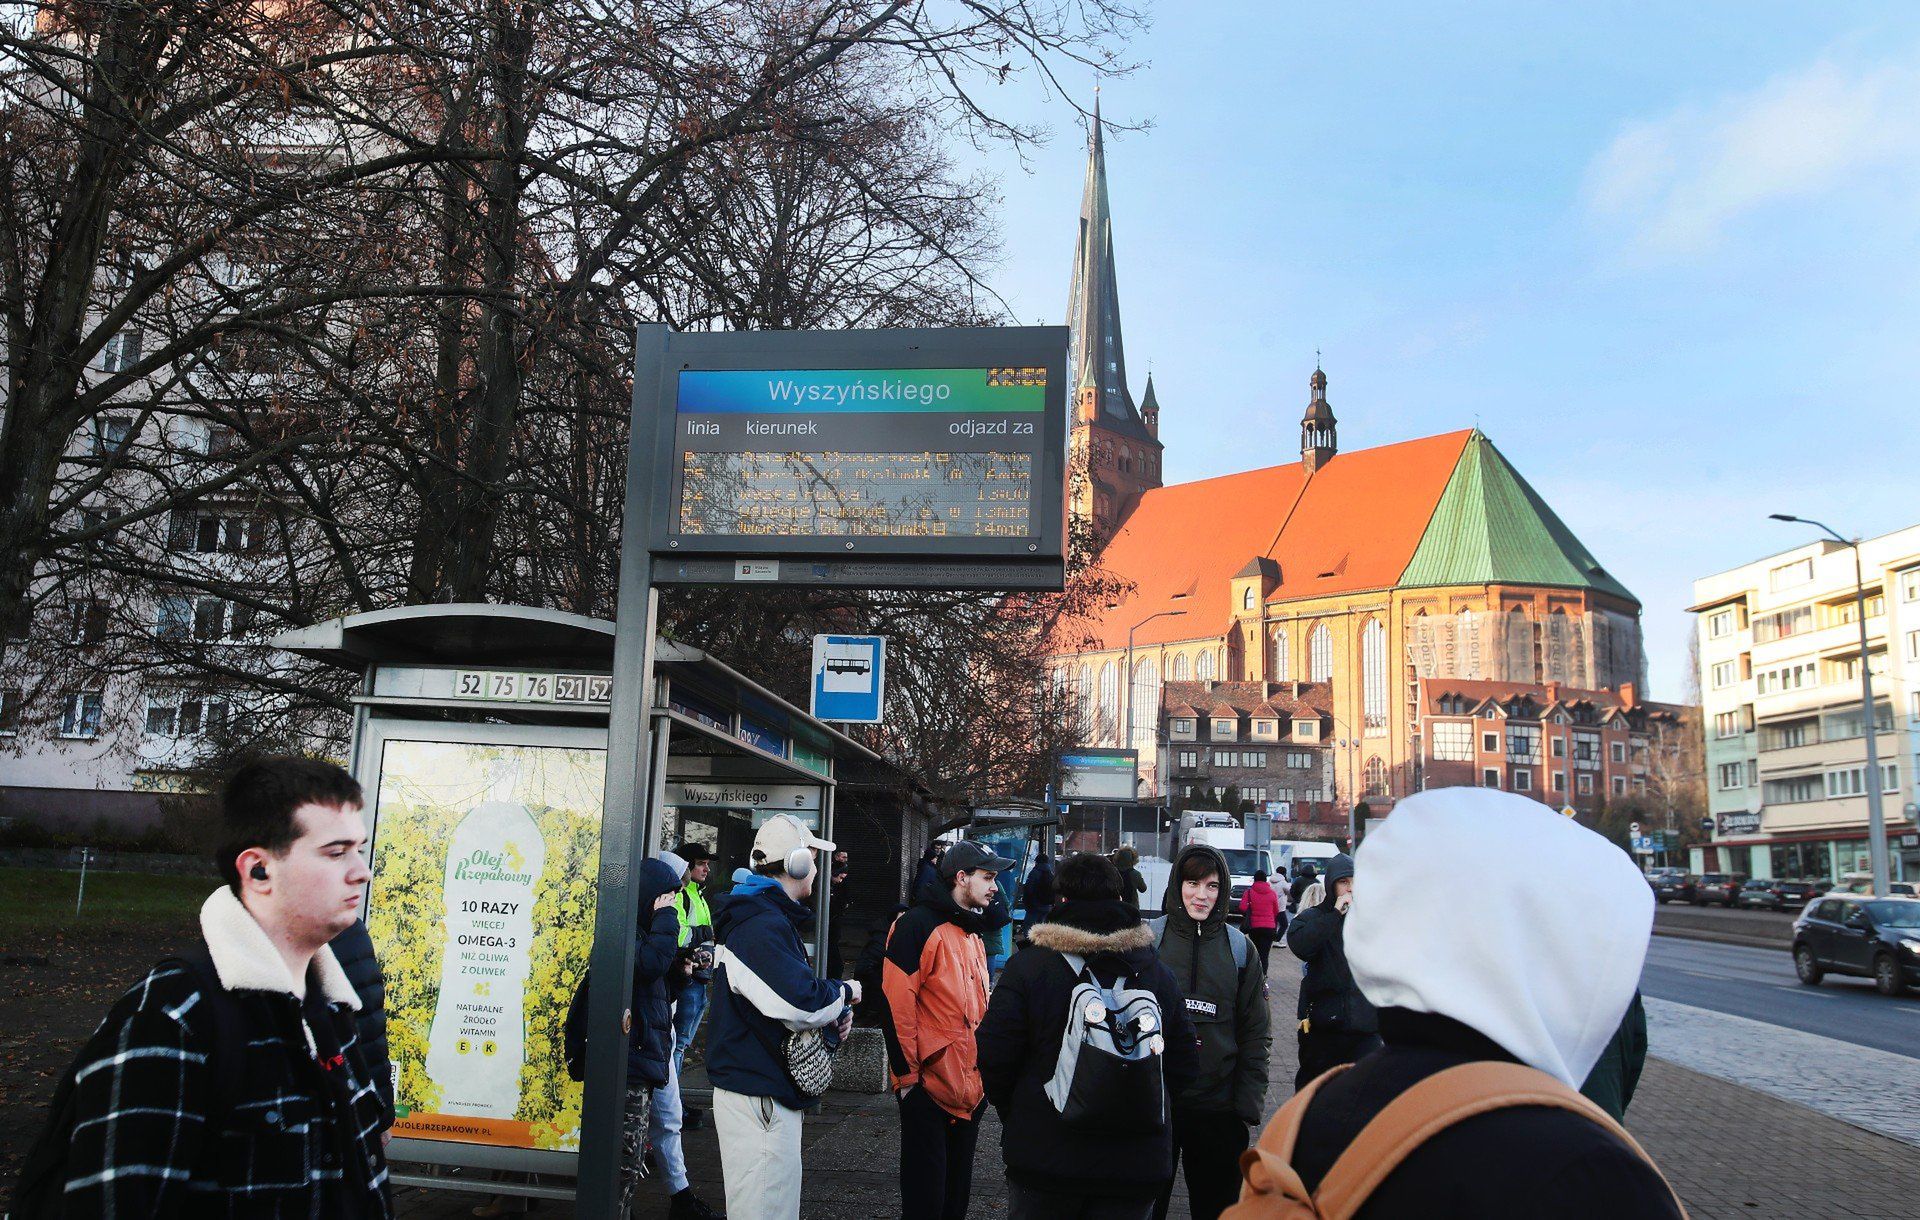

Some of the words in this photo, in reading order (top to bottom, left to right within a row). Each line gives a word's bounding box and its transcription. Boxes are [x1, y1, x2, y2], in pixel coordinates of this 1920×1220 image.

[768, 379, 951, 405] Wyszyńskiego
[687, 421, 720, 435] linia
[746, 420, 818, 435] kierunek
[949, 420, 1007, 437] odjazd
[1012, 423, 1034, 435] za
[460, 674, 481, 694] 52
[494, 675, 514, 696] 75
[527, 677, 547, 697] 76
[556, 678, 583, 699] 521
[684, 788, 768, 805] Wyszyńskiego
[471, 849, 504, 870] Olej
[454, 857, 532, 886] Rzepakowy
[461, 900, 478, 913] 10
[481, 901, 519, 915] RAZY
[471, 920, 505, 930] WIĘCEJ
[457, 934, 516, 948] OMEGA-3
[478, 952, 510, 963] OLIWA
[461, 965, 468, 975] Z
[469, 966, 506, 976] OLIWEK
[456, 1003, 504, 1014] NATURALNE
[459, 1027, 496, 1037] WITAMIN
[460, 1042, 466, 1051] E
[485, 1044, 493, 1053] K
